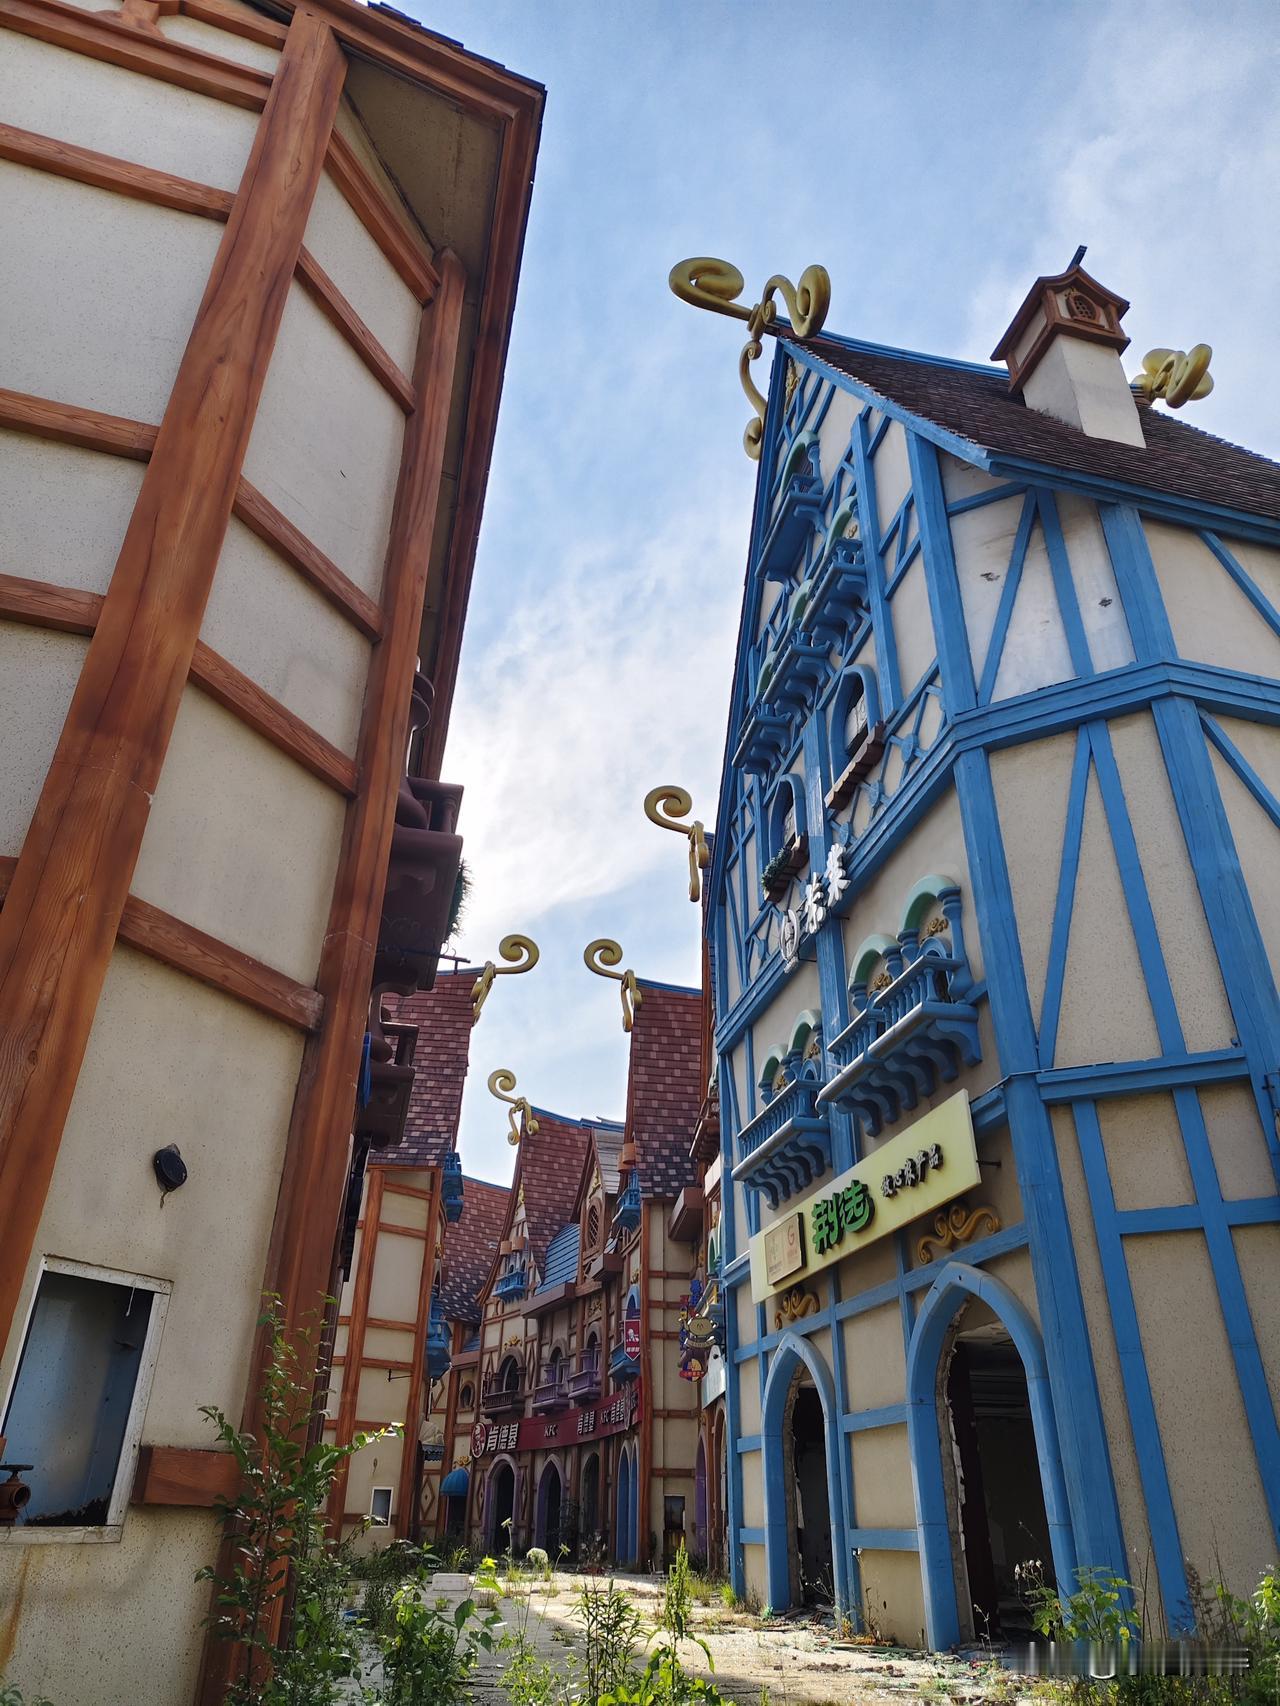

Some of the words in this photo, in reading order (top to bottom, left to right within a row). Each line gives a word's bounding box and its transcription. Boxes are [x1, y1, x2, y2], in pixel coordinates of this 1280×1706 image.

[486, 1422, 519, 1451] 肯德基
[544, 1424, 558, 1437] KFC
